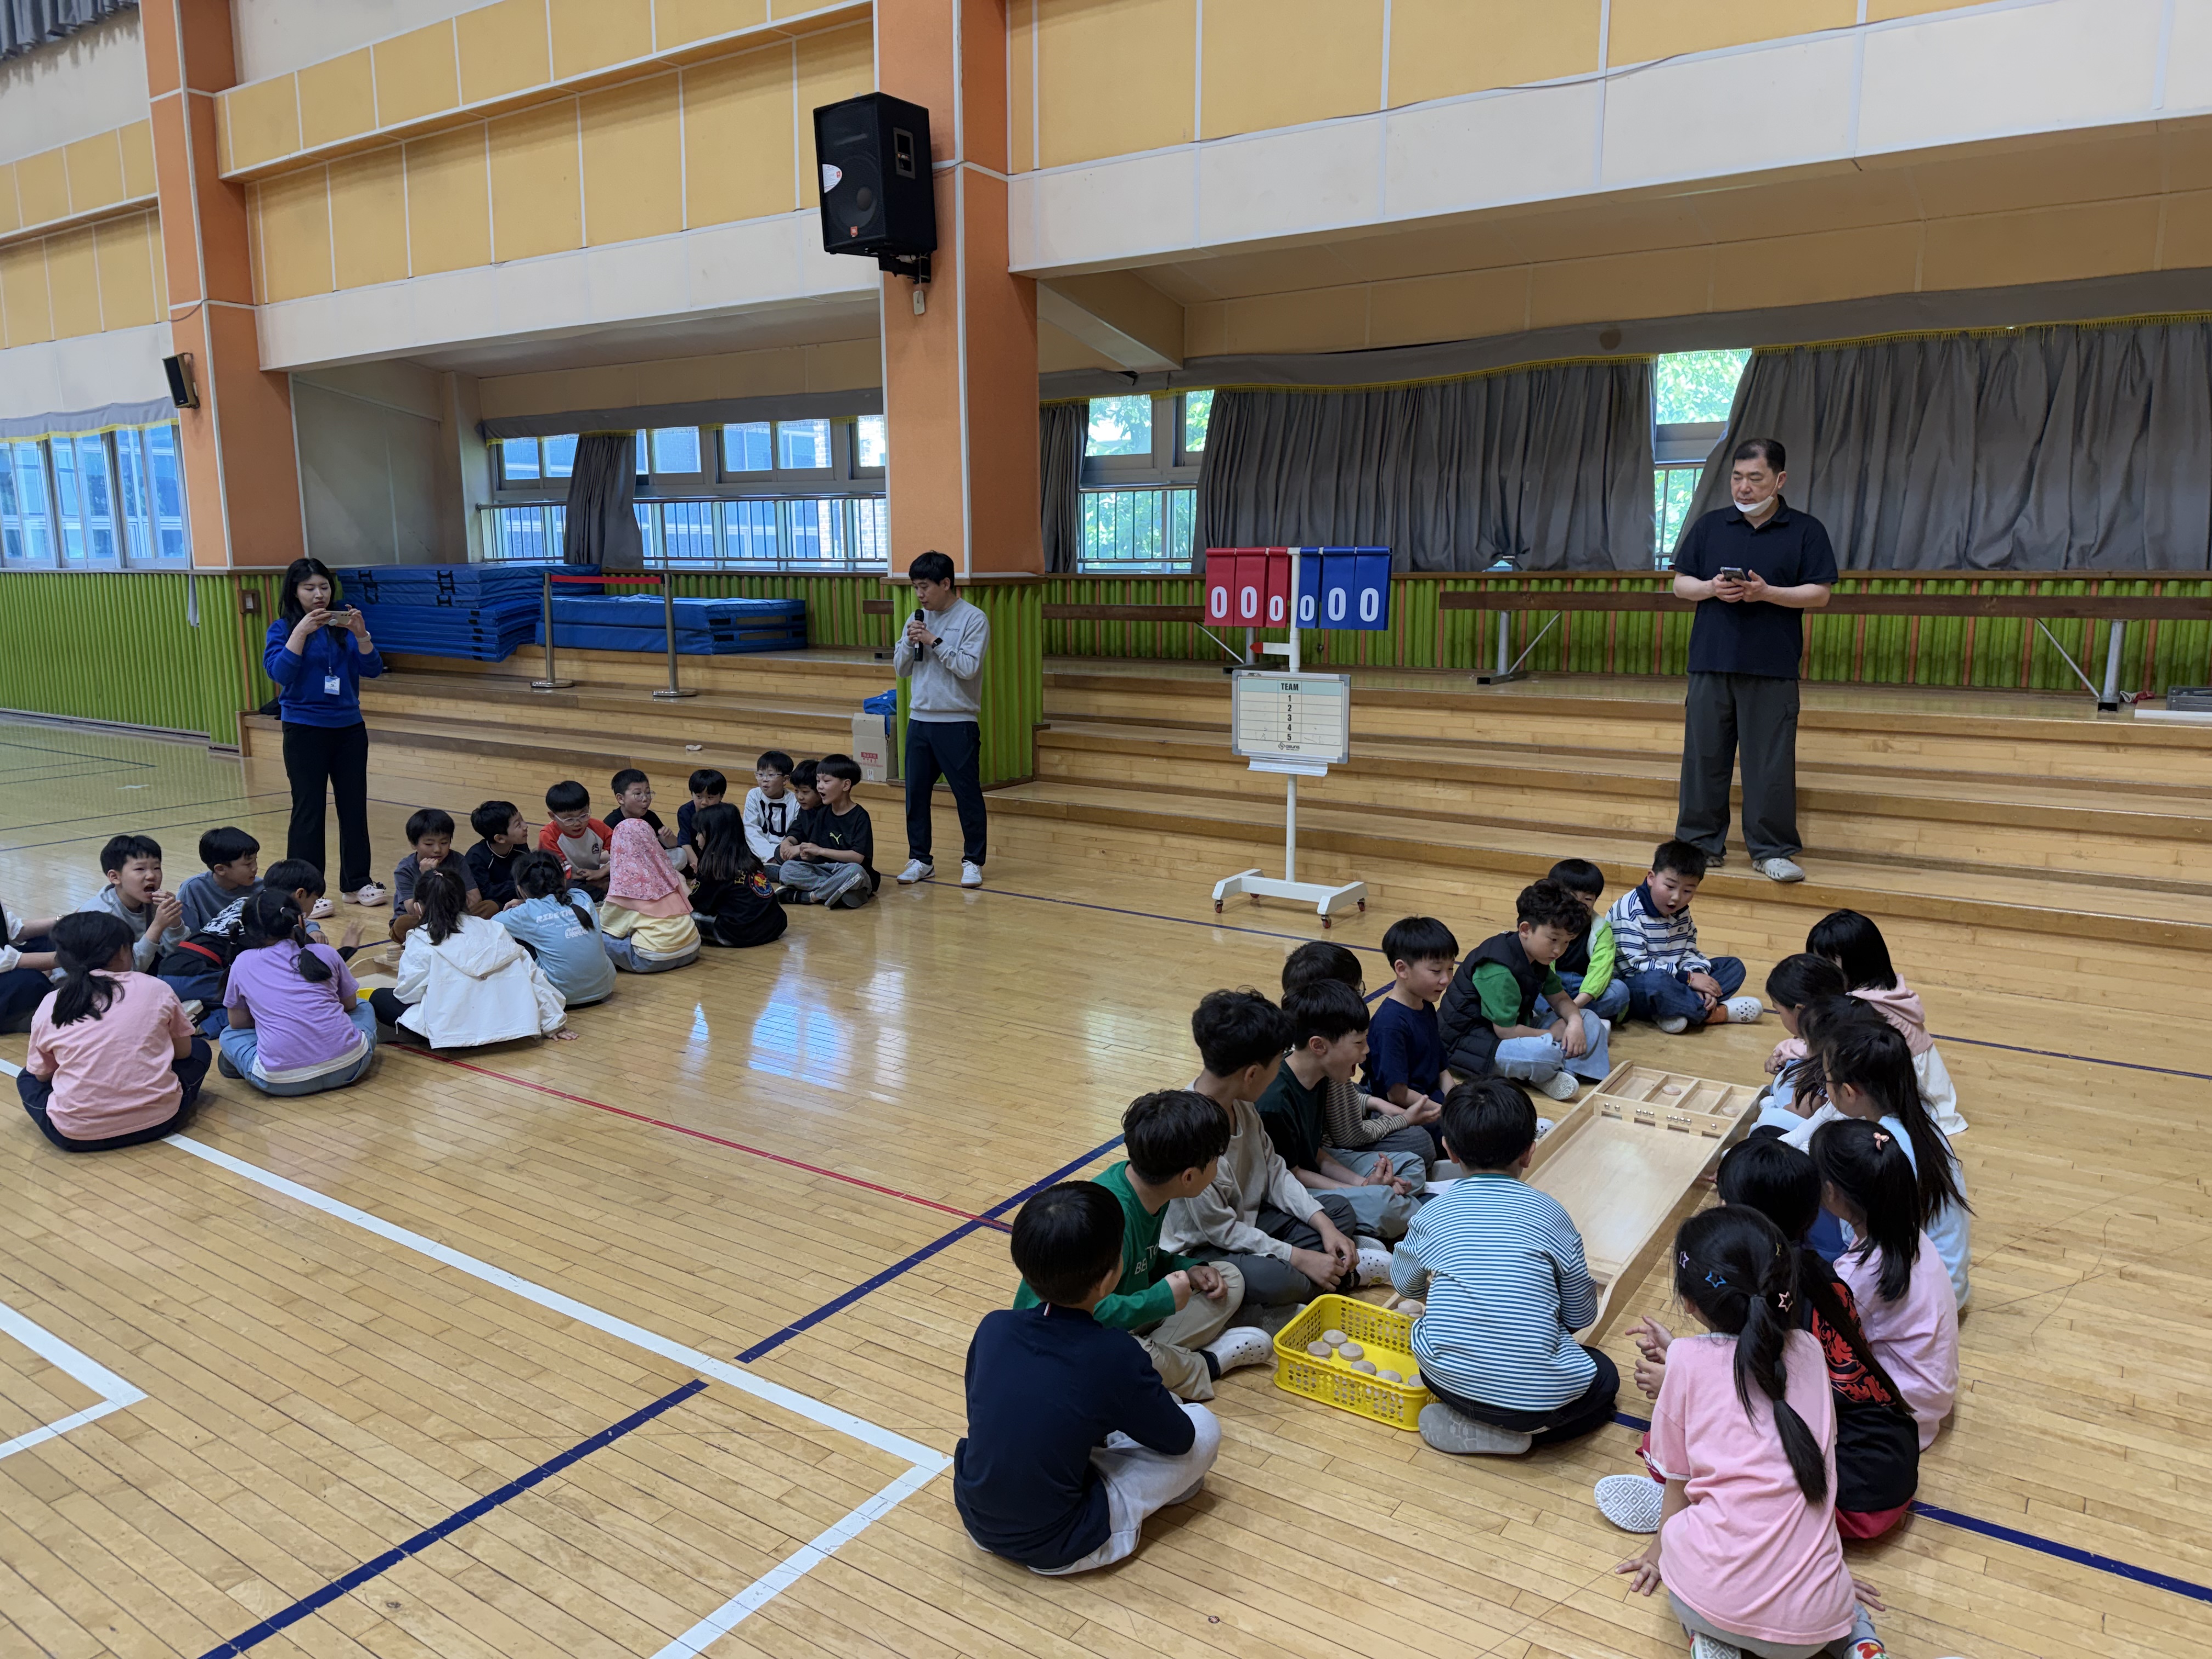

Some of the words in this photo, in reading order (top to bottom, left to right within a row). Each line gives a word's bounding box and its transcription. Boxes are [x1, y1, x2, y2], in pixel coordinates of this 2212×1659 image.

[1269, 595, 1284, 622] 0
[1299, 595, 1315, 621] 0
[1281, 682, 1299, 691] TEAM
